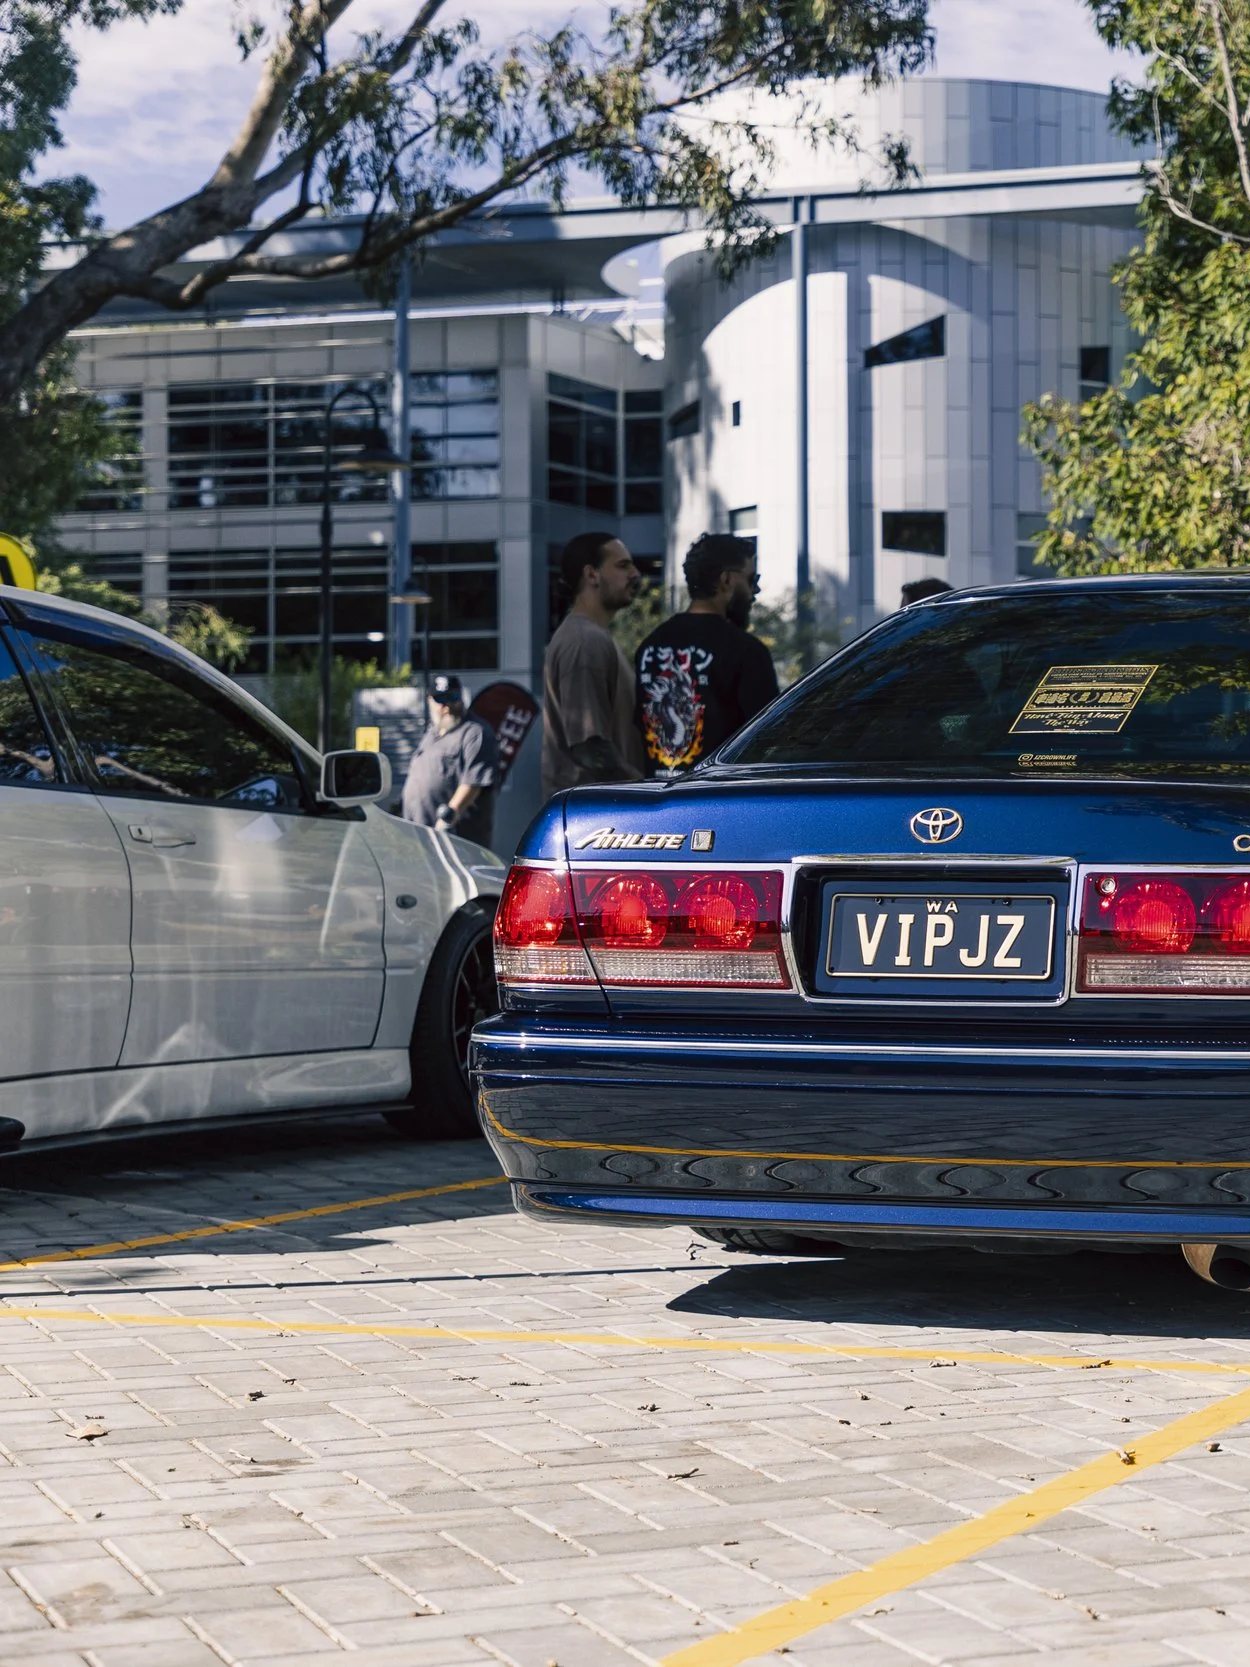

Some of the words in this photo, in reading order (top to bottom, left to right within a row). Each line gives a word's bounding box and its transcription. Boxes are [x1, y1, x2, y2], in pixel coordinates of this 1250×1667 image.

[640, 645, 714, 672] ドラゴン
[575, 827, 688, 850] ATHLETE
[926, 900, 959, 913] WA
[856, 913, 1026, 968] VIPJZ
